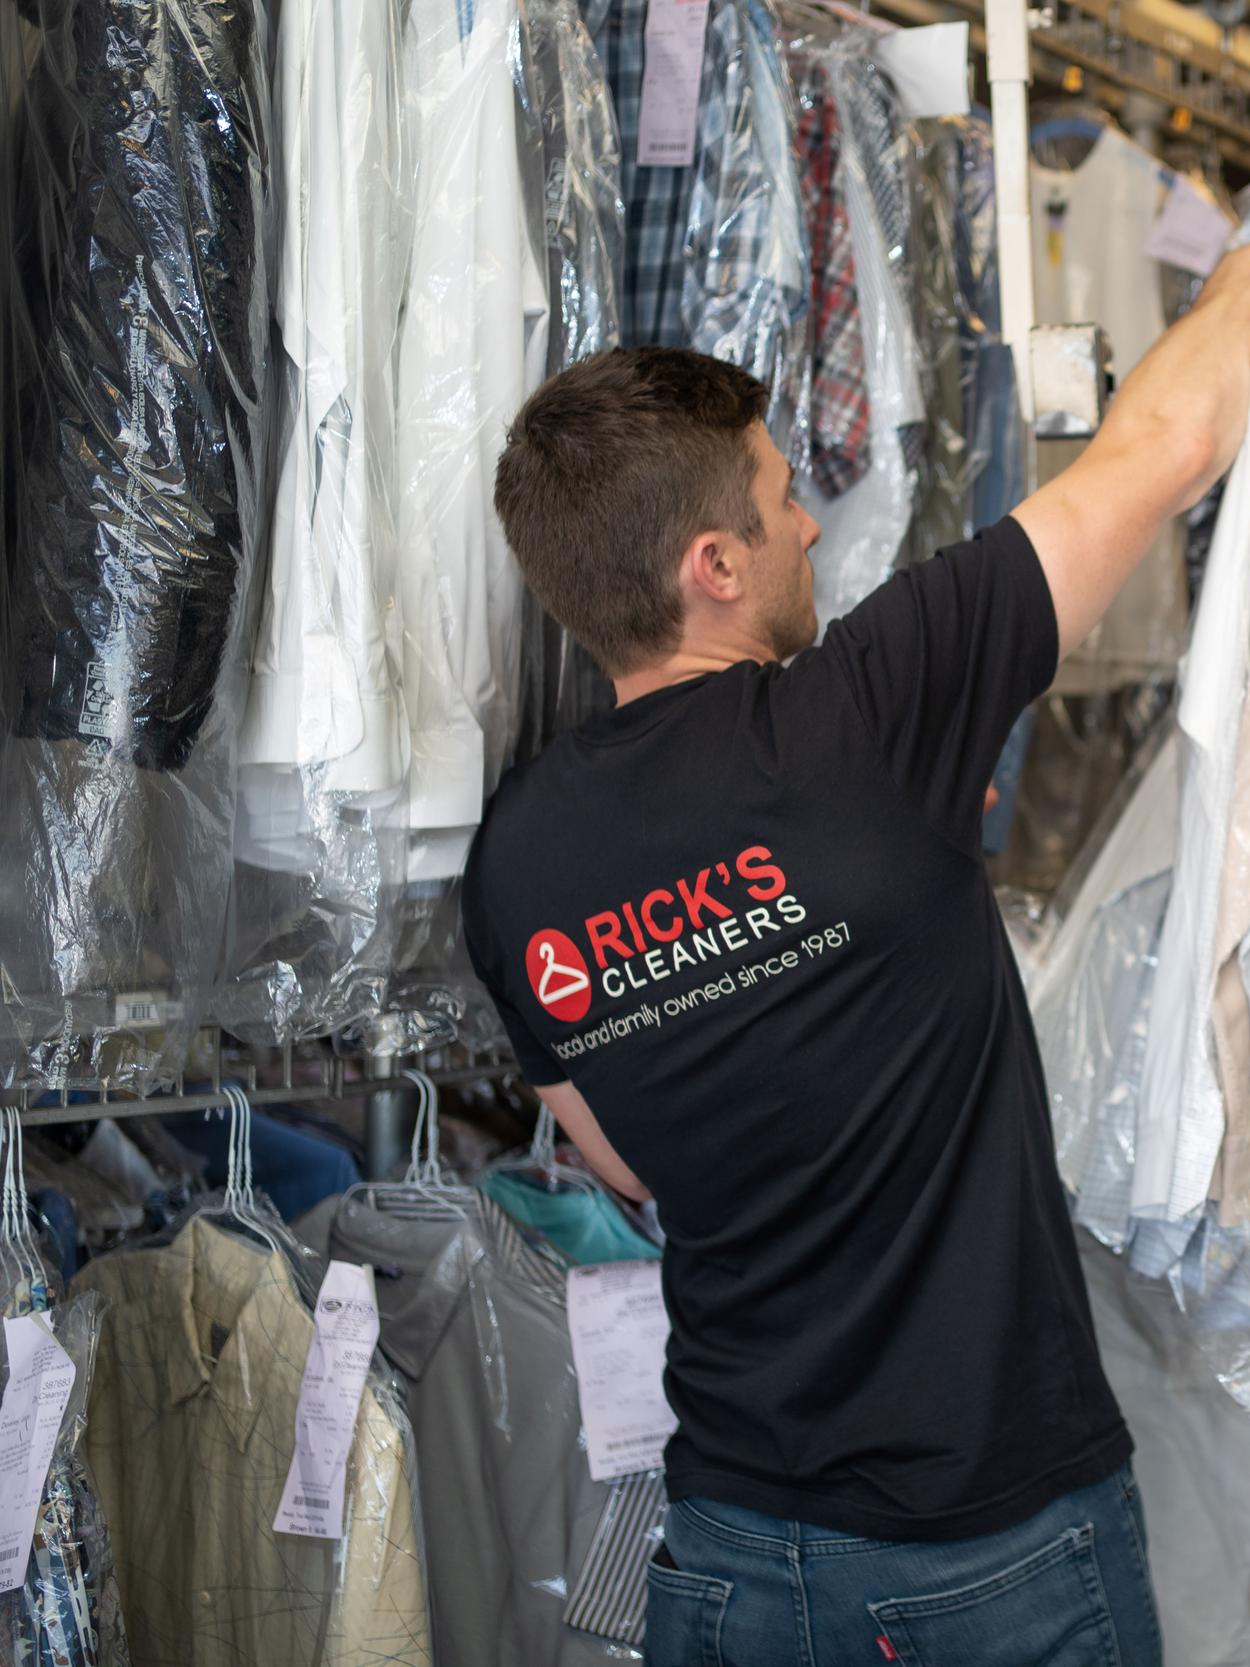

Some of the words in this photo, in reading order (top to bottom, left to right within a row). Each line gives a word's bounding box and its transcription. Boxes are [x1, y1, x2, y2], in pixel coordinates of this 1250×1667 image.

[585, 845, 787, 969] RICK'S
[602, 895, 807, 998] CLEANERS
[584, 1021, 611, 1050] and
[609, 1003, 661, 1039] family
[664, 972, 736, 1016] owned
[738, 951, 799, 988] since
[801, 921, 850, 959] 1987
